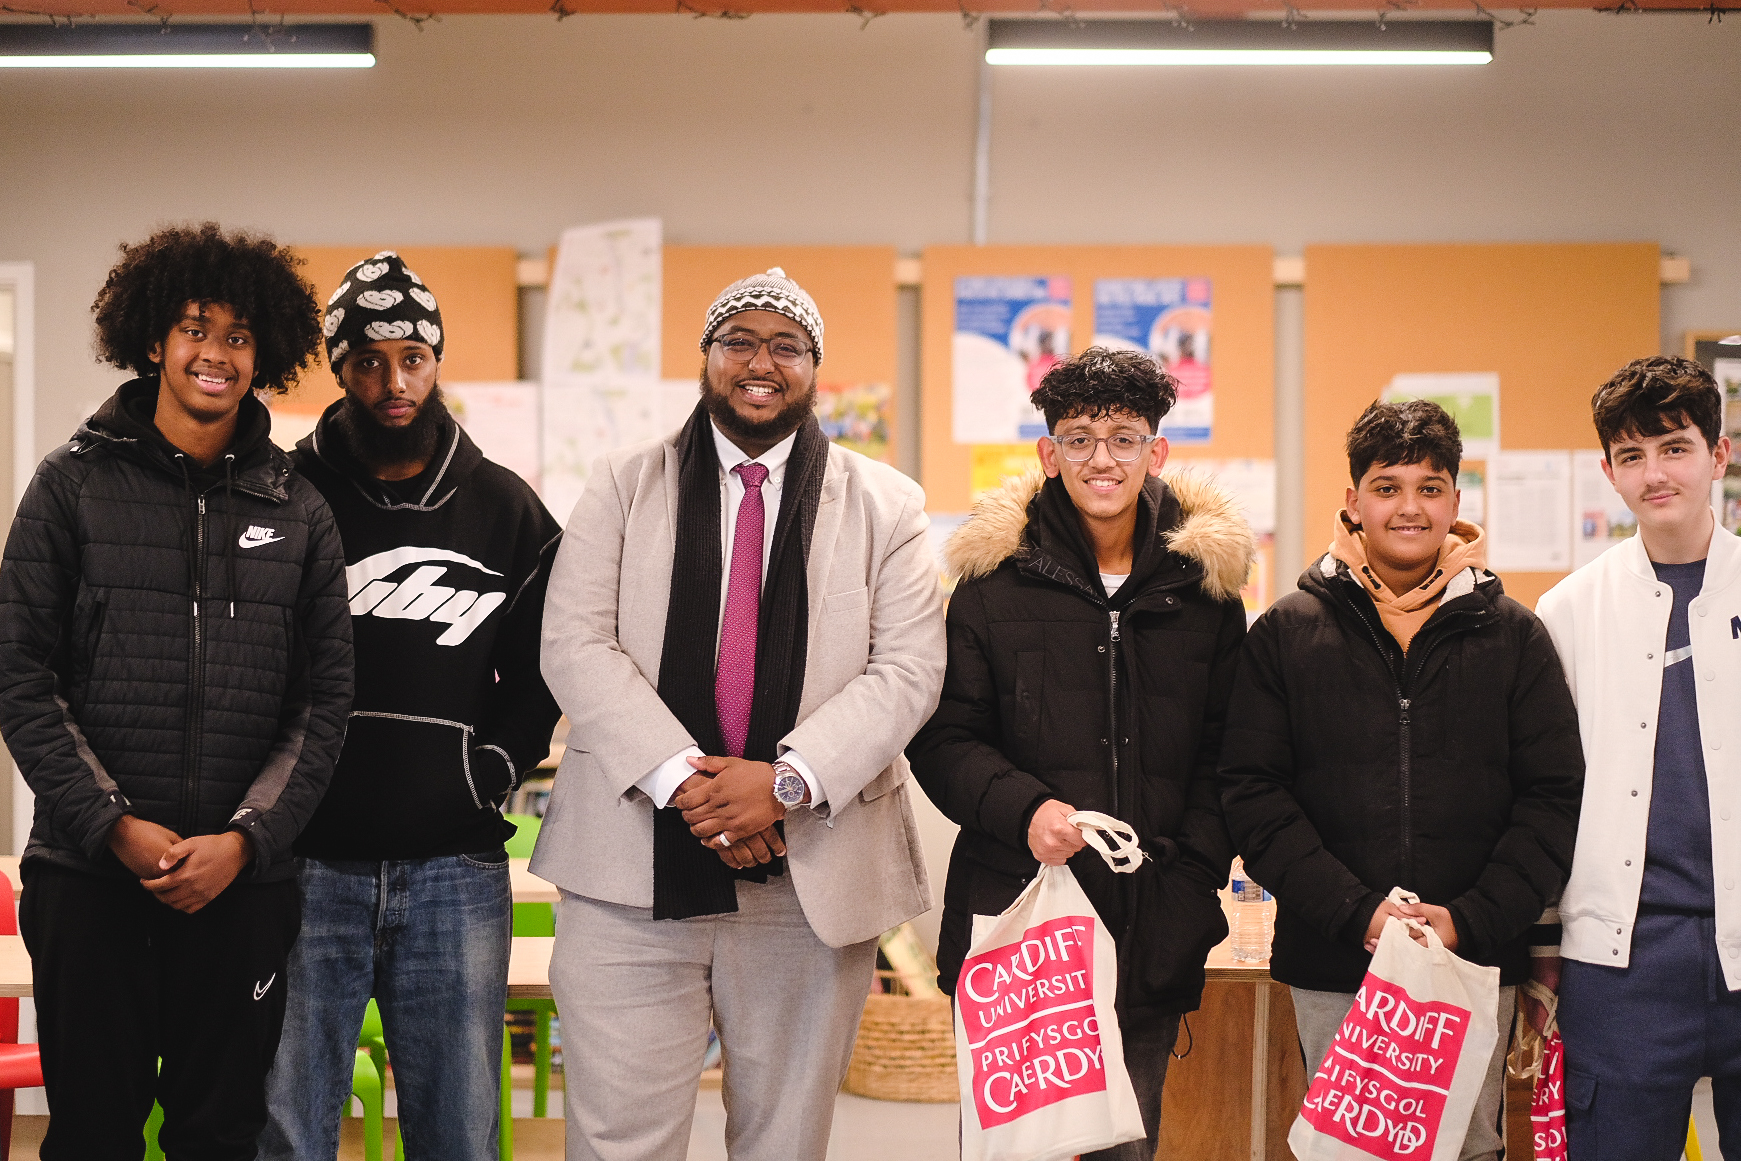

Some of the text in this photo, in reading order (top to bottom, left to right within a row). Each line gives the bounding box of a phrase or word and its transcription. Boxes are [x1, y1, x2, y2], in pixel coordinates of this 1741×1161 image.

[246, 525, 275, 540] NIKE
[1029, 554, 1098, 596] ALESSA
[1335, 1022, 1444, 1075] NIVERSITY
[983, 1045, 1103, 1113] CAERDY
[1324, 1055, 1417, 1118] IFYSGOL
